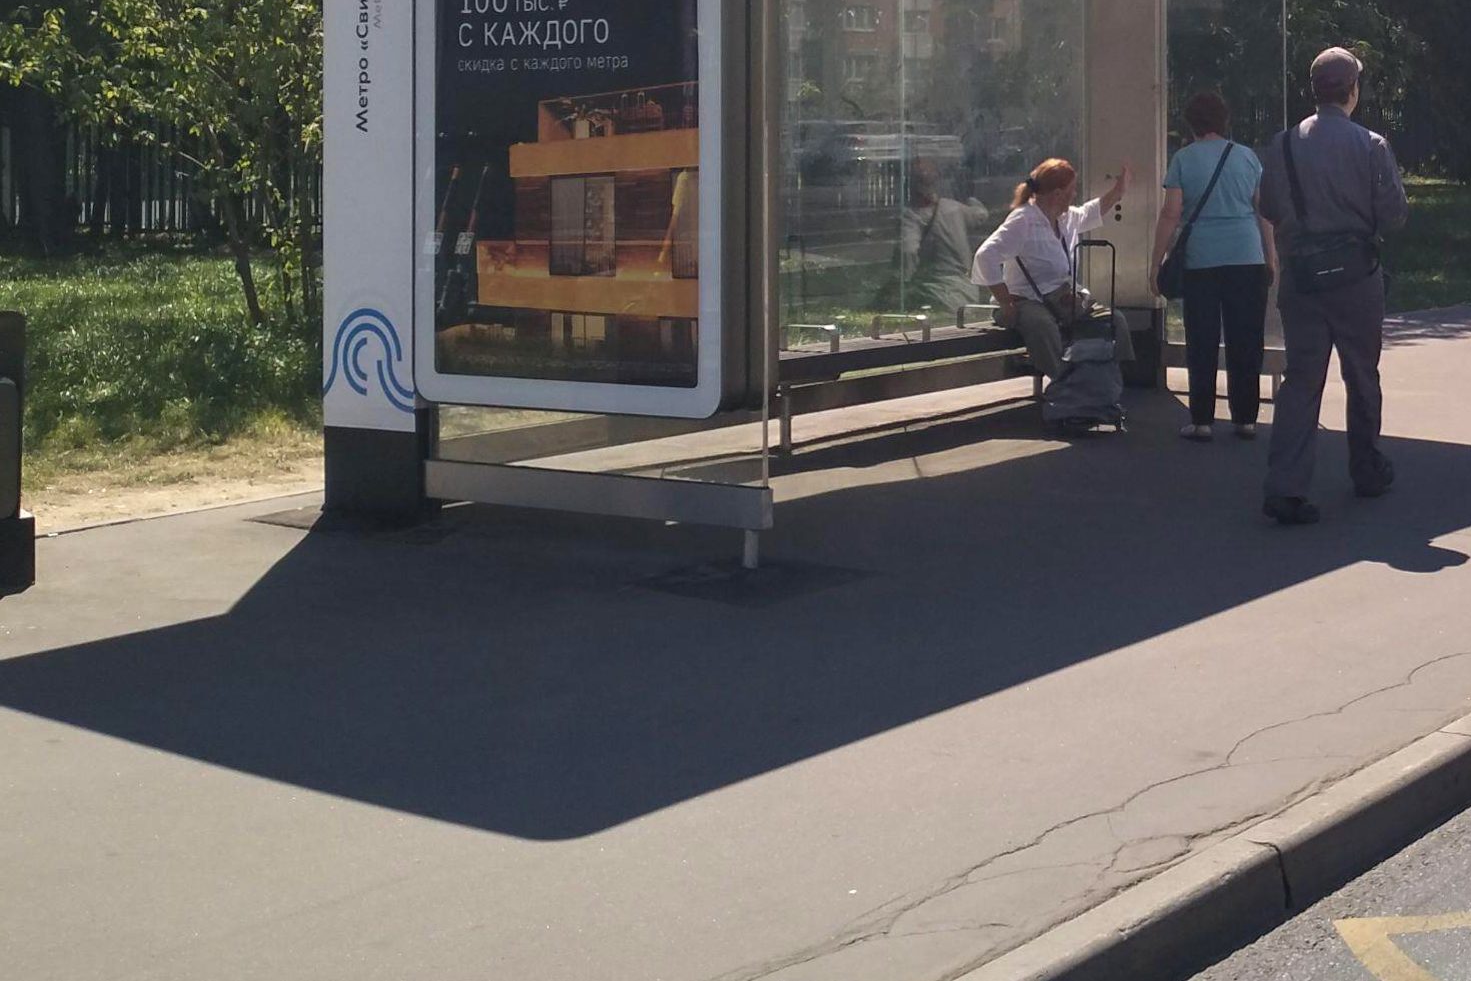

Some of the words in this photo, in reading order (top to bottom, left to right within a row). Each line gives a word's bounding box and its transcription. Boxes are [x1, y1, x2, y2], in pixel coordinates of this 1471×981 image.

[458, 23, 473, 47] С
[484, 18, 610, 50] КАЖДОГО
[457, 58, 505, 73] скидка
[510, 58, 518, 70] с
[523, 56, 582, 71] каждого
[586, 54, 629, 72] метра
[356, 57, 371, 132] Метро
